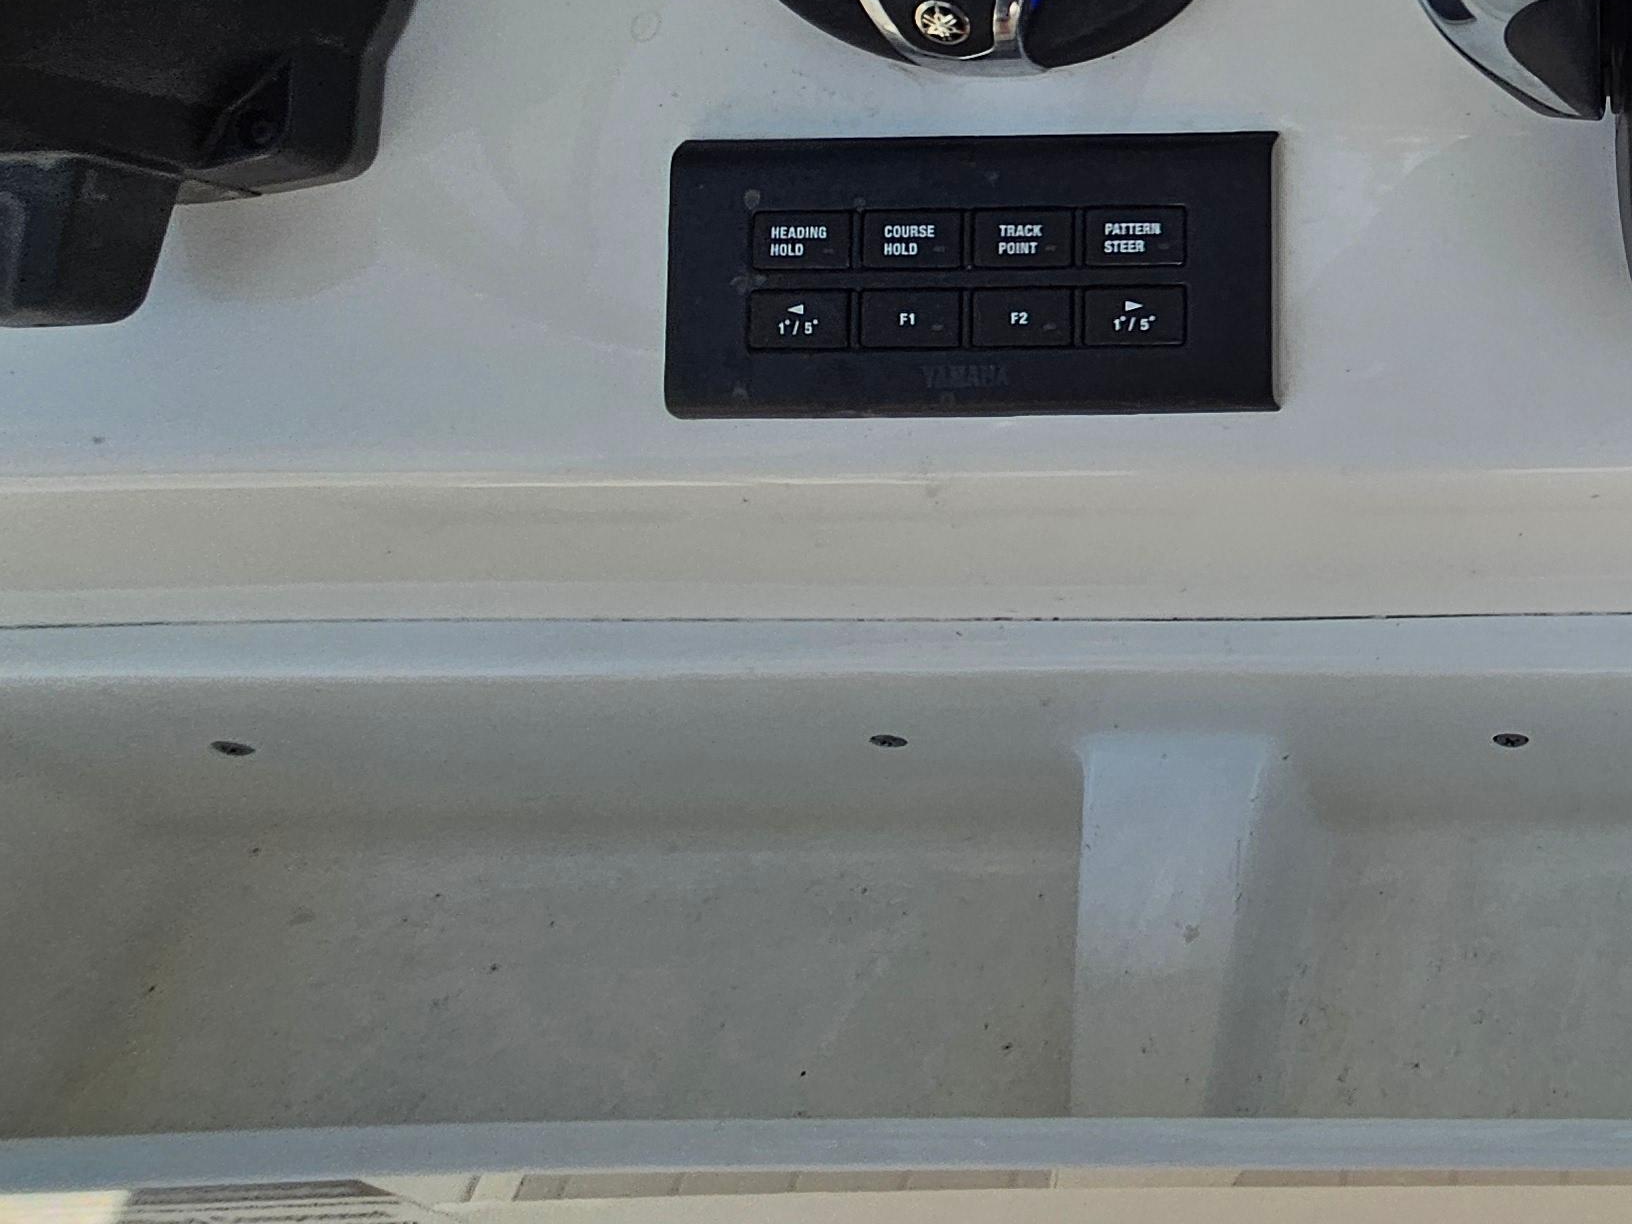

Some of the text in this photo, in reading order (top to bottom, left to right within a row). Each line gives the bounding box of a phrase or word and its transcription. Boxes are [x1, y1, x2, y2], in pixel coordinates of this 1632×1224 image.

[770, 225, 828, 240] HEADING
[884, 224, 936, 239] COURSE
[998, 223, 1043, 238] TRACK
[1104, 222, 1162, 236] PATTERN
[769, 242, 804, 257] HOLD
[884, 242, 918, 256] HOLD
[998, 241, 1038, 256] POINT
[1104, 239, 1146, 254] STEER
[899, 312, 916, 325] F1
[1010, 311, 1029, 325] F2
